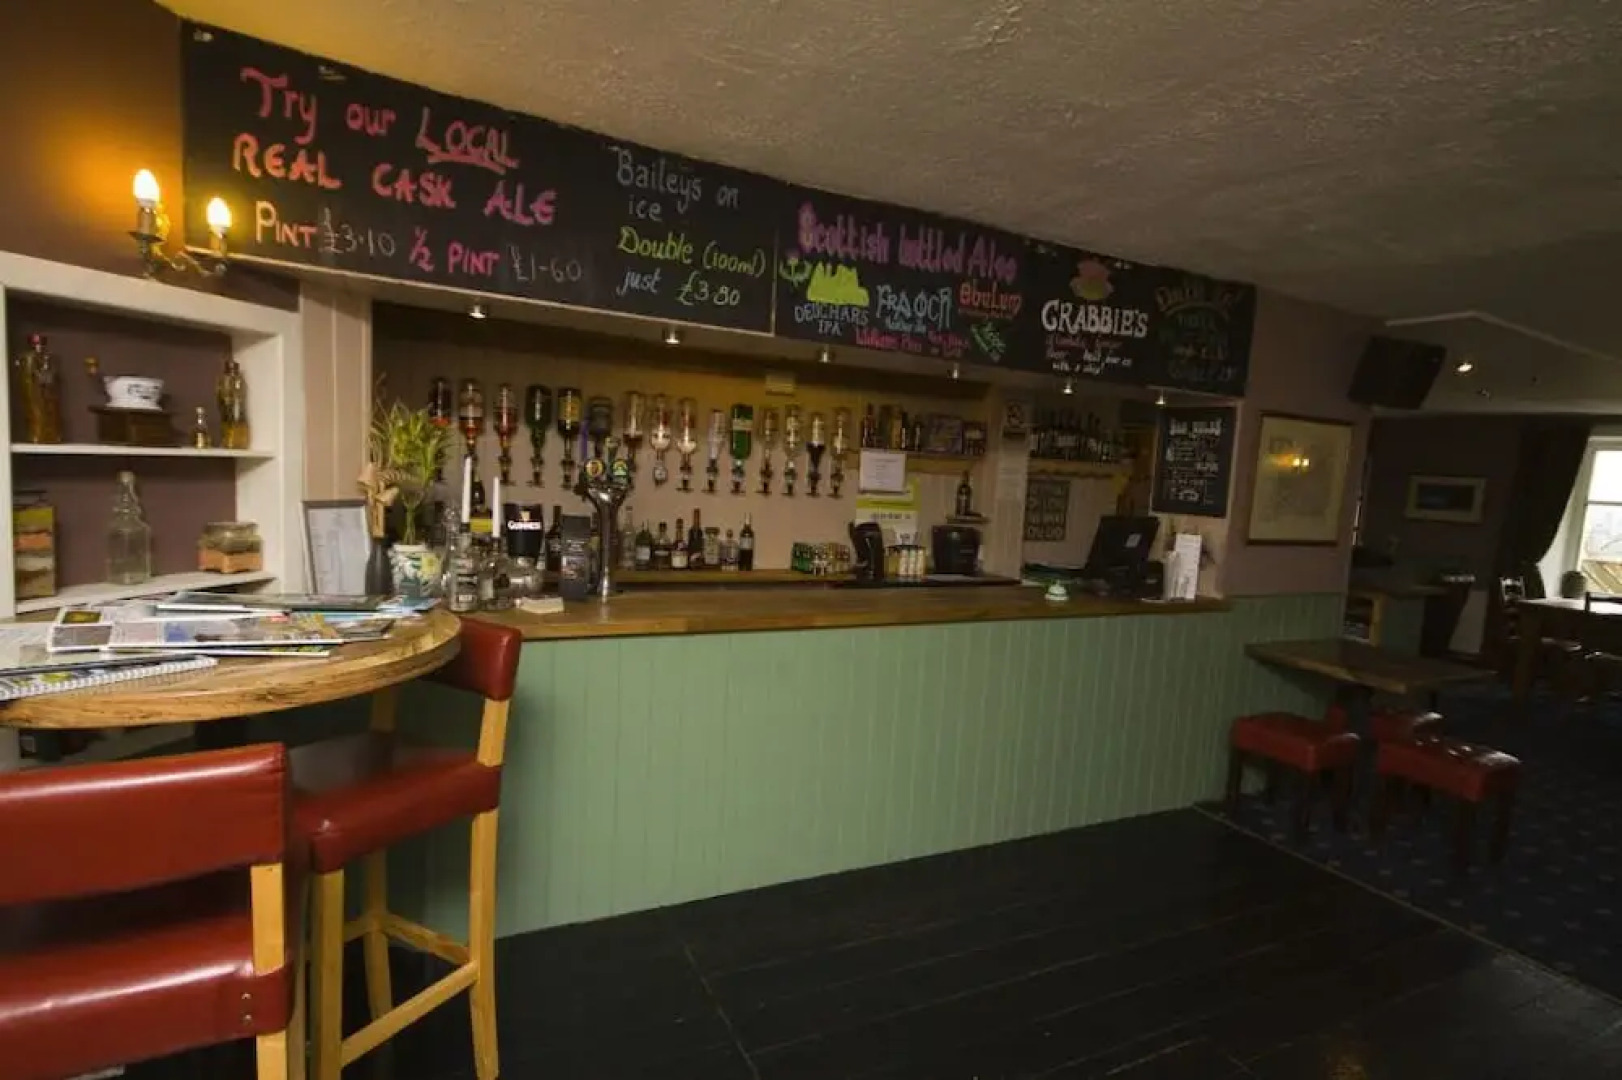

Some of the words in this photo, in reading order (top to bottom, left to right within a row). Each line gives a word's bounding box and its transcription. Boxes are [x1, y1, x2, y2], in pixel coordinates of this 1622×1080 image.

[241, 67, 317, 145] Try
[345, 102, 396, 137] our
[415, 106, 519, 173] LOCAL
[232, 133, 342, 189] REAL
[371, 163, 456, 209] CASK
[484, 180, 558, 226] ALE
[608, 146, 702, 215] Baileys
[716, 185, 739, 209] on
[628, 194, 662, 222] ice
[255, 201, 318, 249] PINT
[617, 225, 694, 265] Double
[702, 240, 767, 278] (100ml)
[797, 199, 890, 265] Scottish
[616, 267, 661, 297] just
